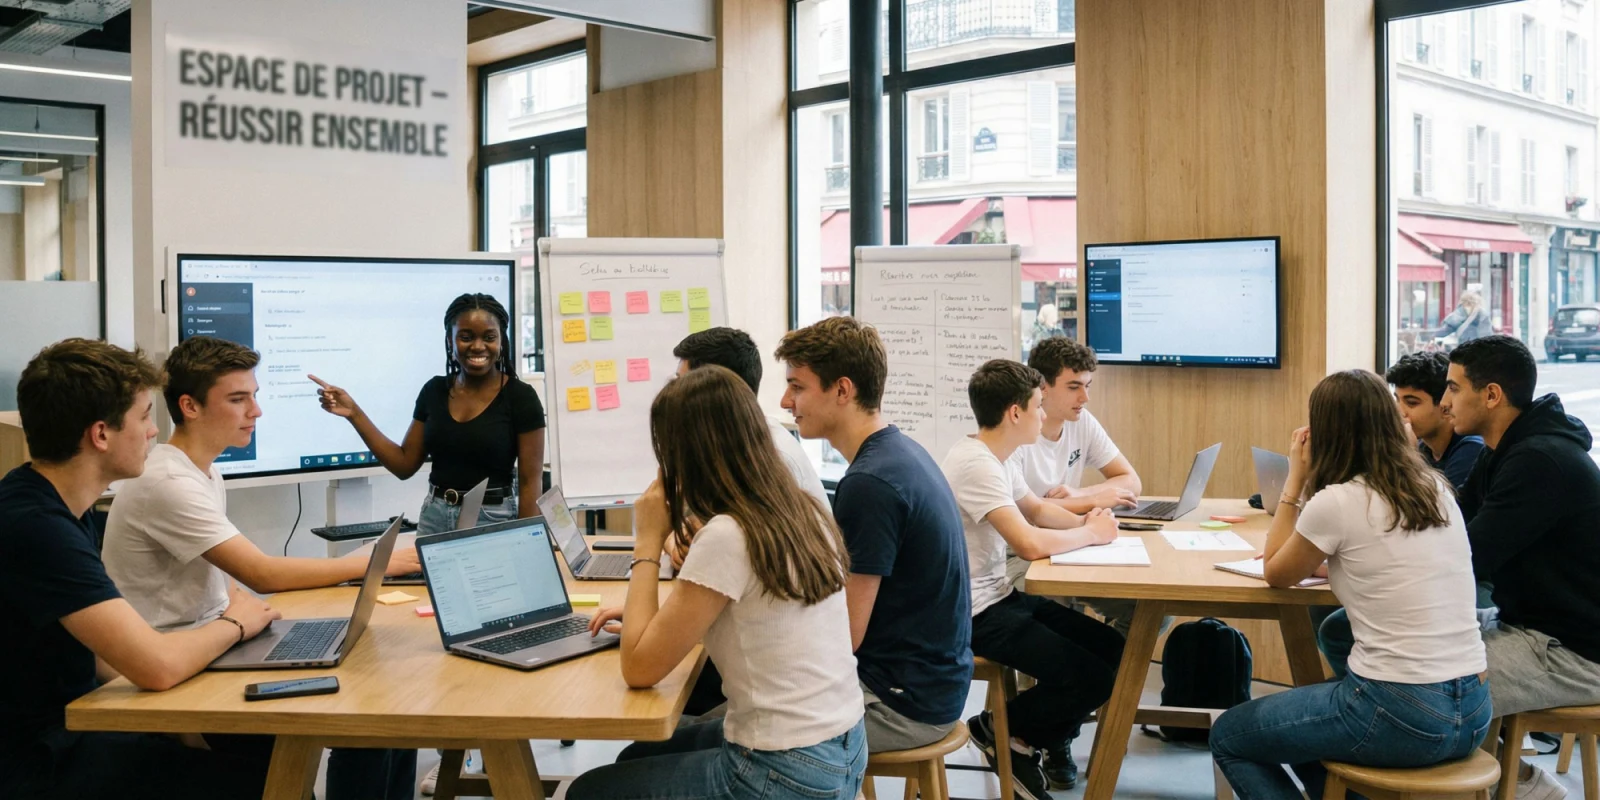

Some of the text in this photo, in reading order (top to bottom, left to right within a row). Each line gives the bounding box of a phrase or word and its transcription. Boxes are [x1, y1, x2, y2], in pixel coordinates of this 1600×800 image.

[179, 48, 286, 95] ESPACE
[294, 61, 328, 99] DE
[335, 66, 425, 107] PROJET
[179, 94, 448, 157] RÉUSSIR ENSEMBLE
